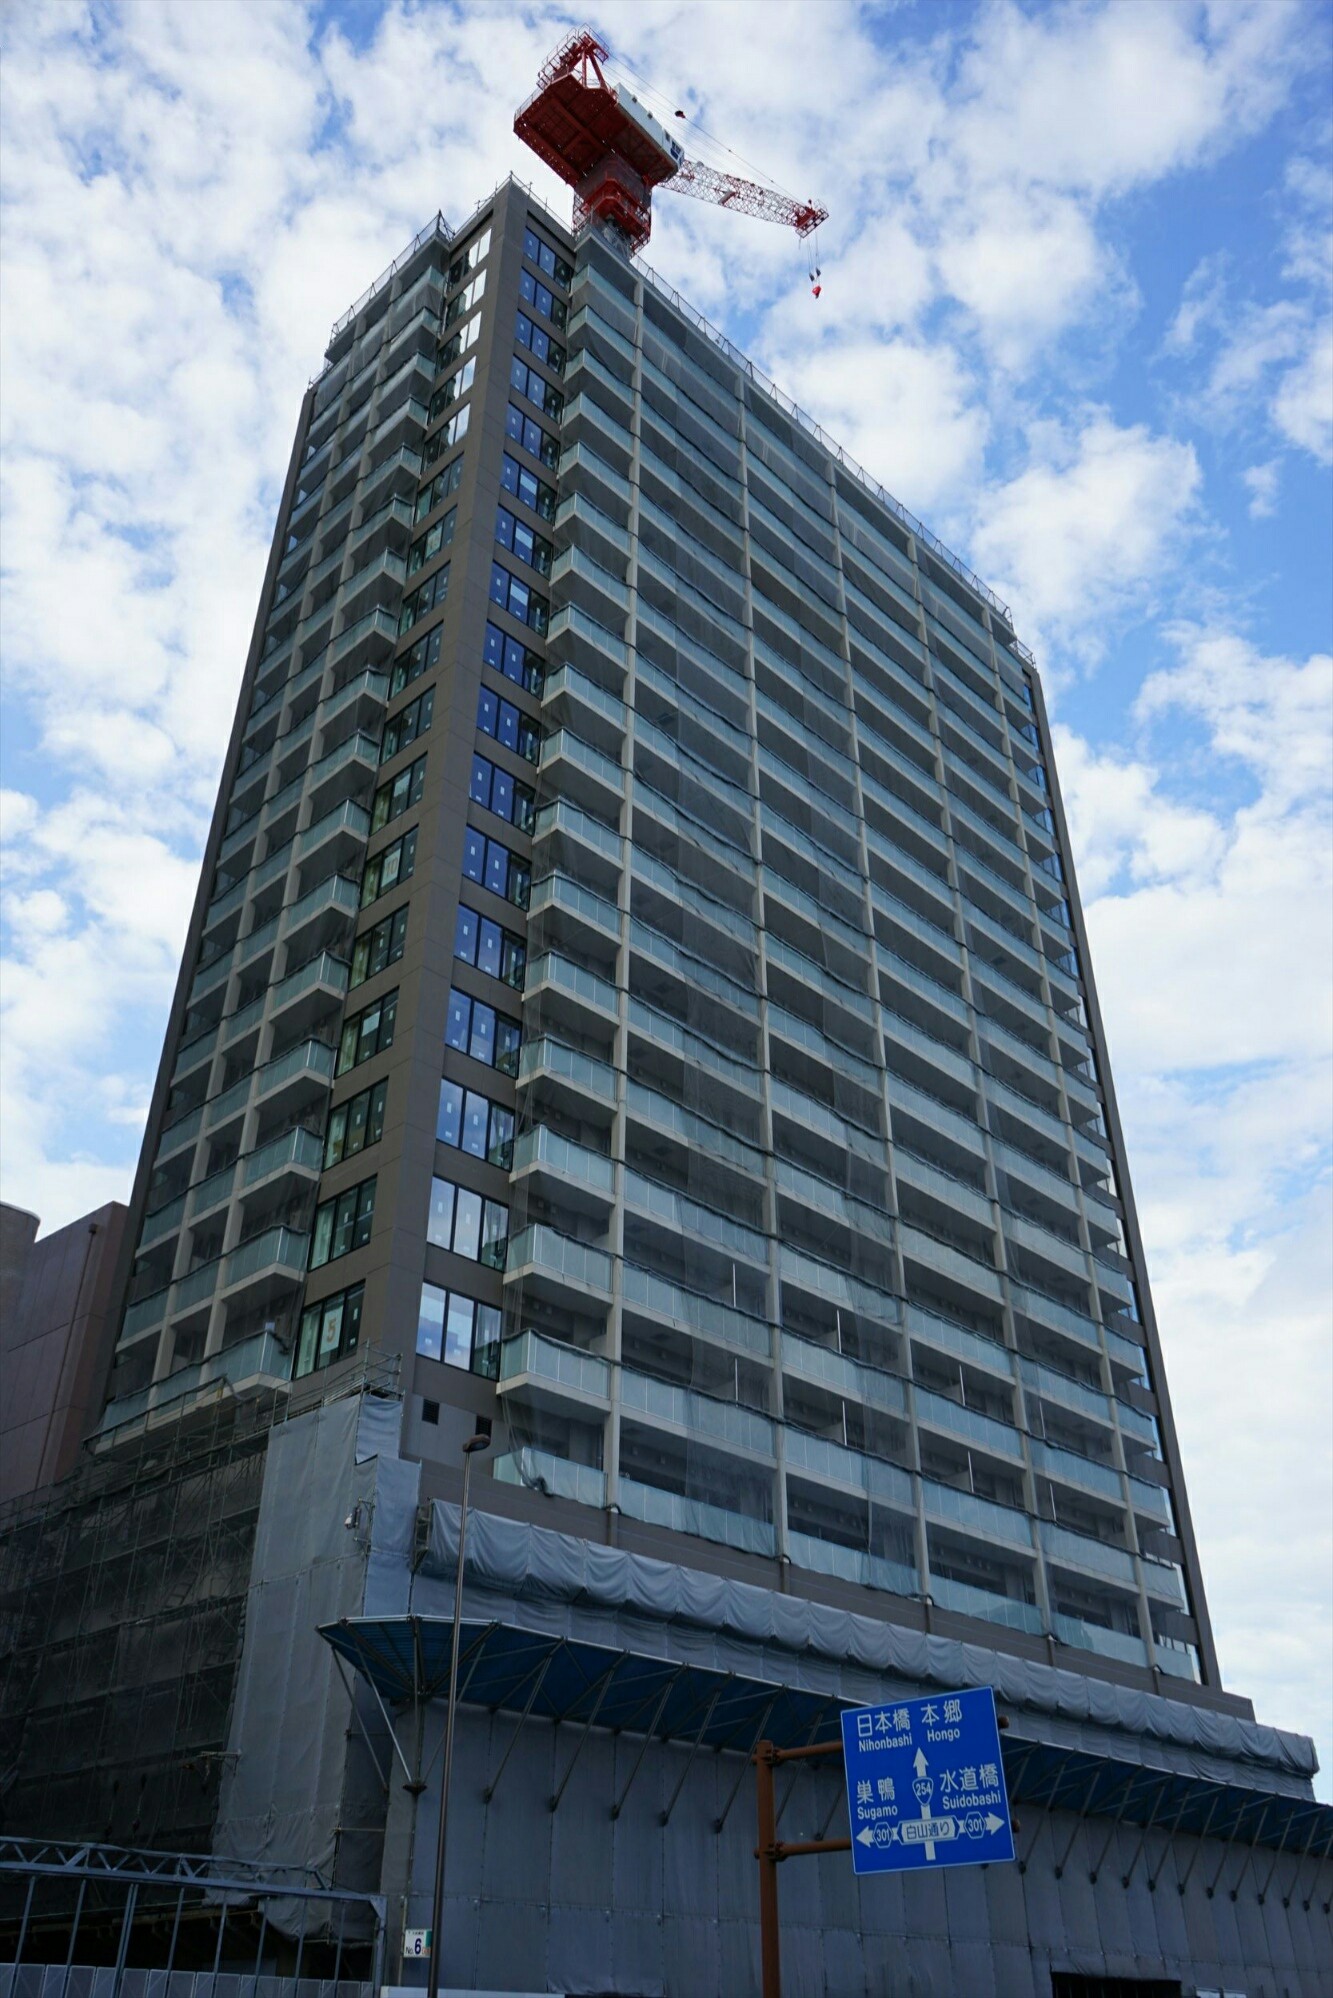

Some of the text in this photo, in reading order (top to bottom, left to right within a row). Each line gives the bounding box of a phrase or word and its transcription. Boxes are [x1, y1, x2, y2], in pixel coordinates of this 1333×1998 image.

[327, 1317, 337, 1344] 5
[857, 1699, 962, 1737] 日本橋 本郷
[858, 1728, 960, 1752] Nihonbashi Hongo
[939, 1763, 999, 1793] 水道橋
[857, 1776, 896, 1804] 巣鴨
[916, 1782, 932, 1797] 254
[942, 1790, 1001, 1810] Suidobashi
[857, 1804, 898, 1820] Sugamo
[906, 1821, 950, 1840] 白山通り
[967, 1817, 983, 1832] 301
[876, 1828, 890, 1842] 301
